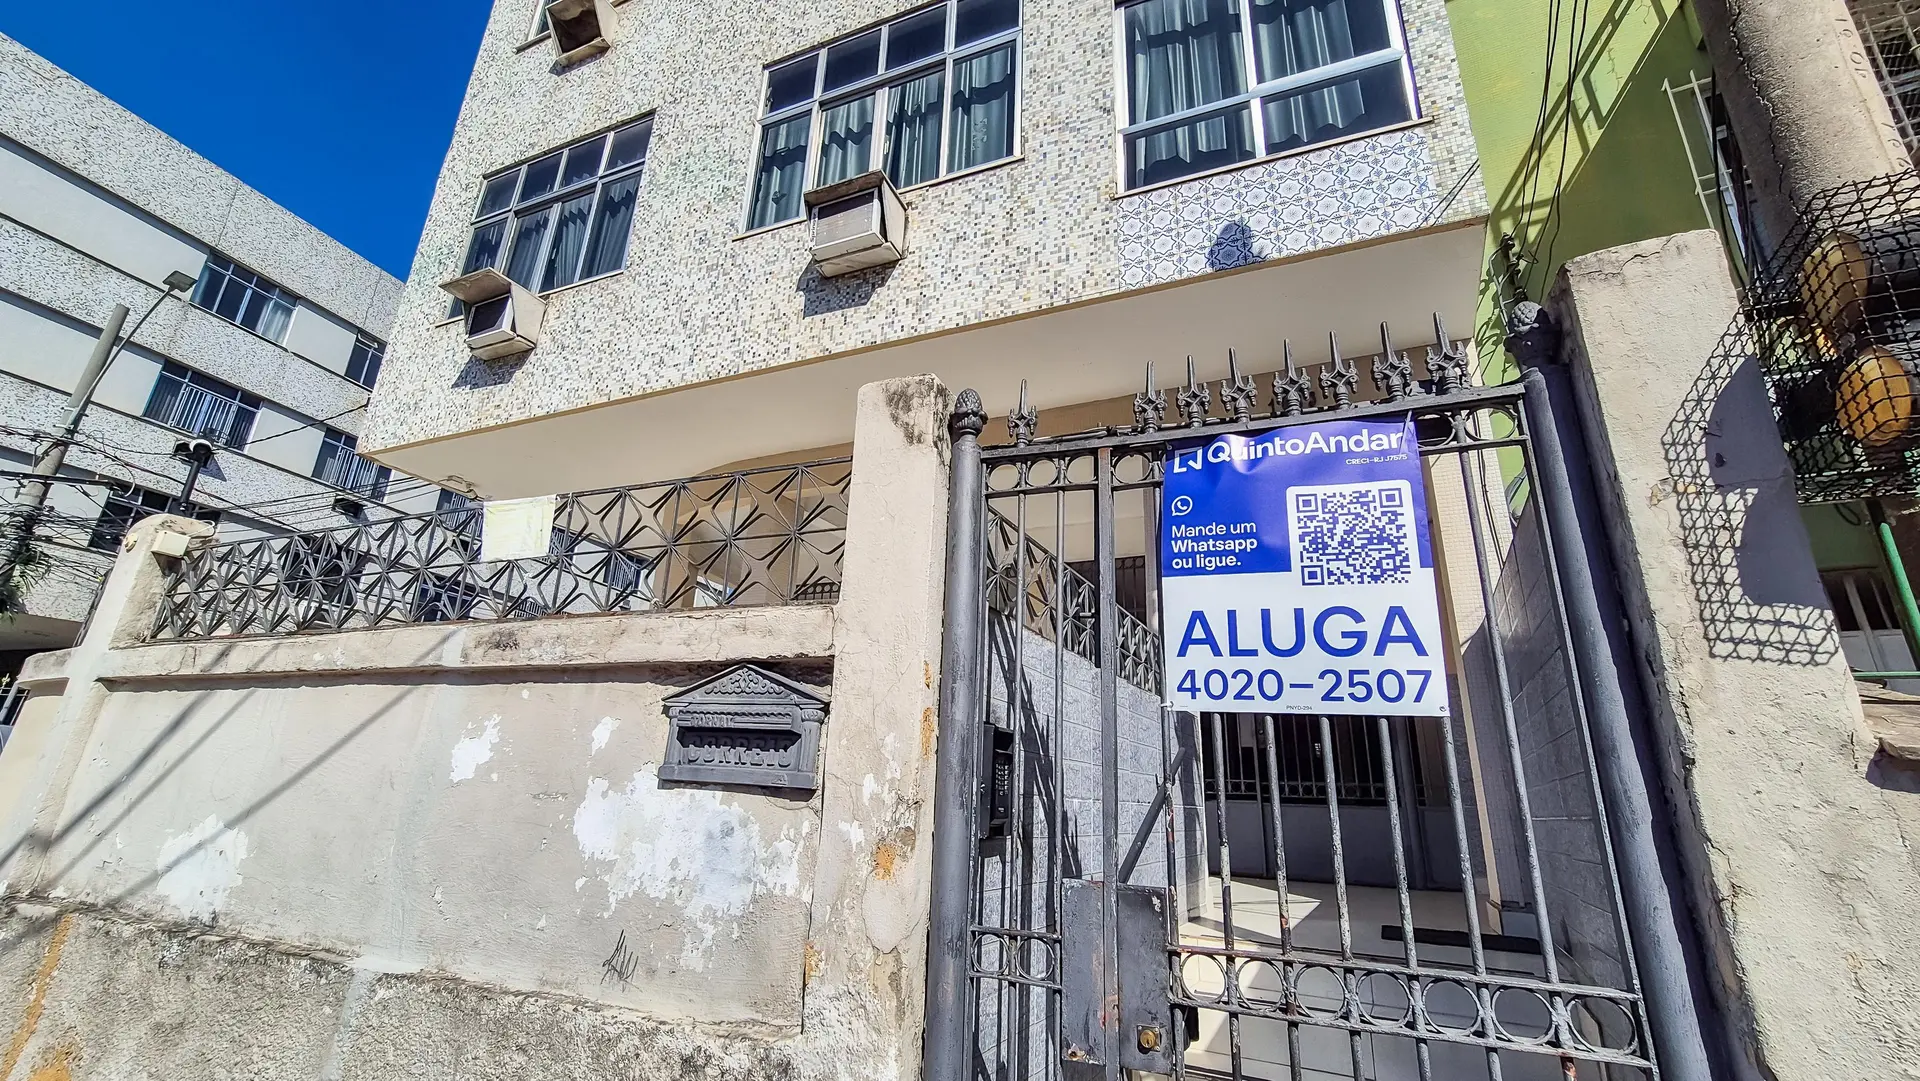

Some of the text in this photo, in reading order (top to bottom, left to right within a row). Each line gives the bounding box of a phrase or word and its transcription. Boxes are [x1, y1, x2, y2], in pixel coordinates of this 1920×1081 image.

[1207, 429, 1403, 464] QuintoAndar
[1345, 457, 1384, 465] CRECI-RJ
[1171, 522, 1257, 538] Mande um
[1171, 538, 1258, 553] Whatsapp
[1172, 554, 1241, 571] ou ligue.
[1176, 605, 1429, 658] ALUGA
[1176, 668, 1432, 704] 4020-2507
